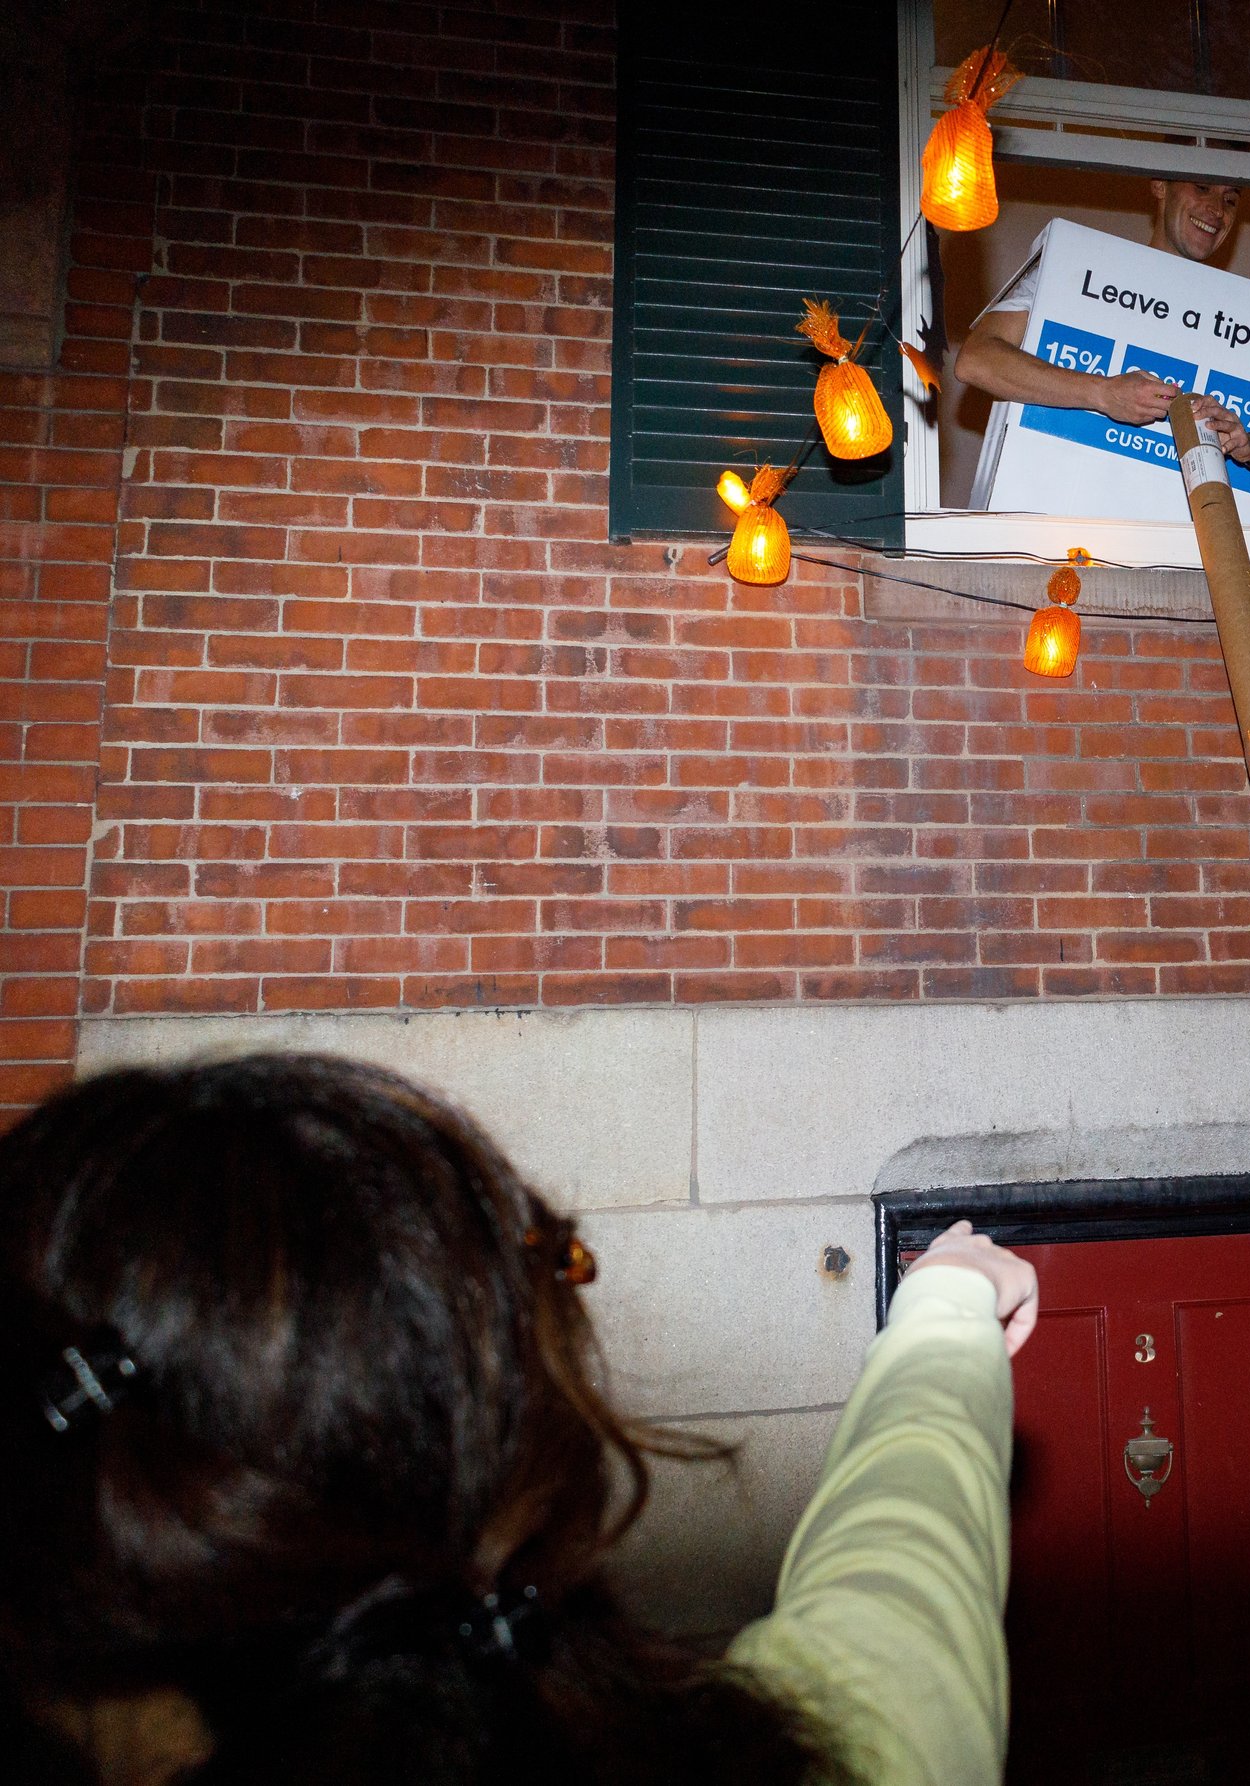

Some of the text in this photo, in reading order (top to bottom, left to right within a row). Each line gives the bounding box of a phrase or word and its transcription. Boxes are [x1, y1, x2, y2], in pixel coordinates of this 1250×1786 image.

[1081, 269, 1170, 320] Leave
[1182, 310, 1201, 330] a
[1046, 341, 1106, 377] 15%
[1105, 428, 1179, 462] CUSTOM
[1134, 1333, 1156, 1363] 3
